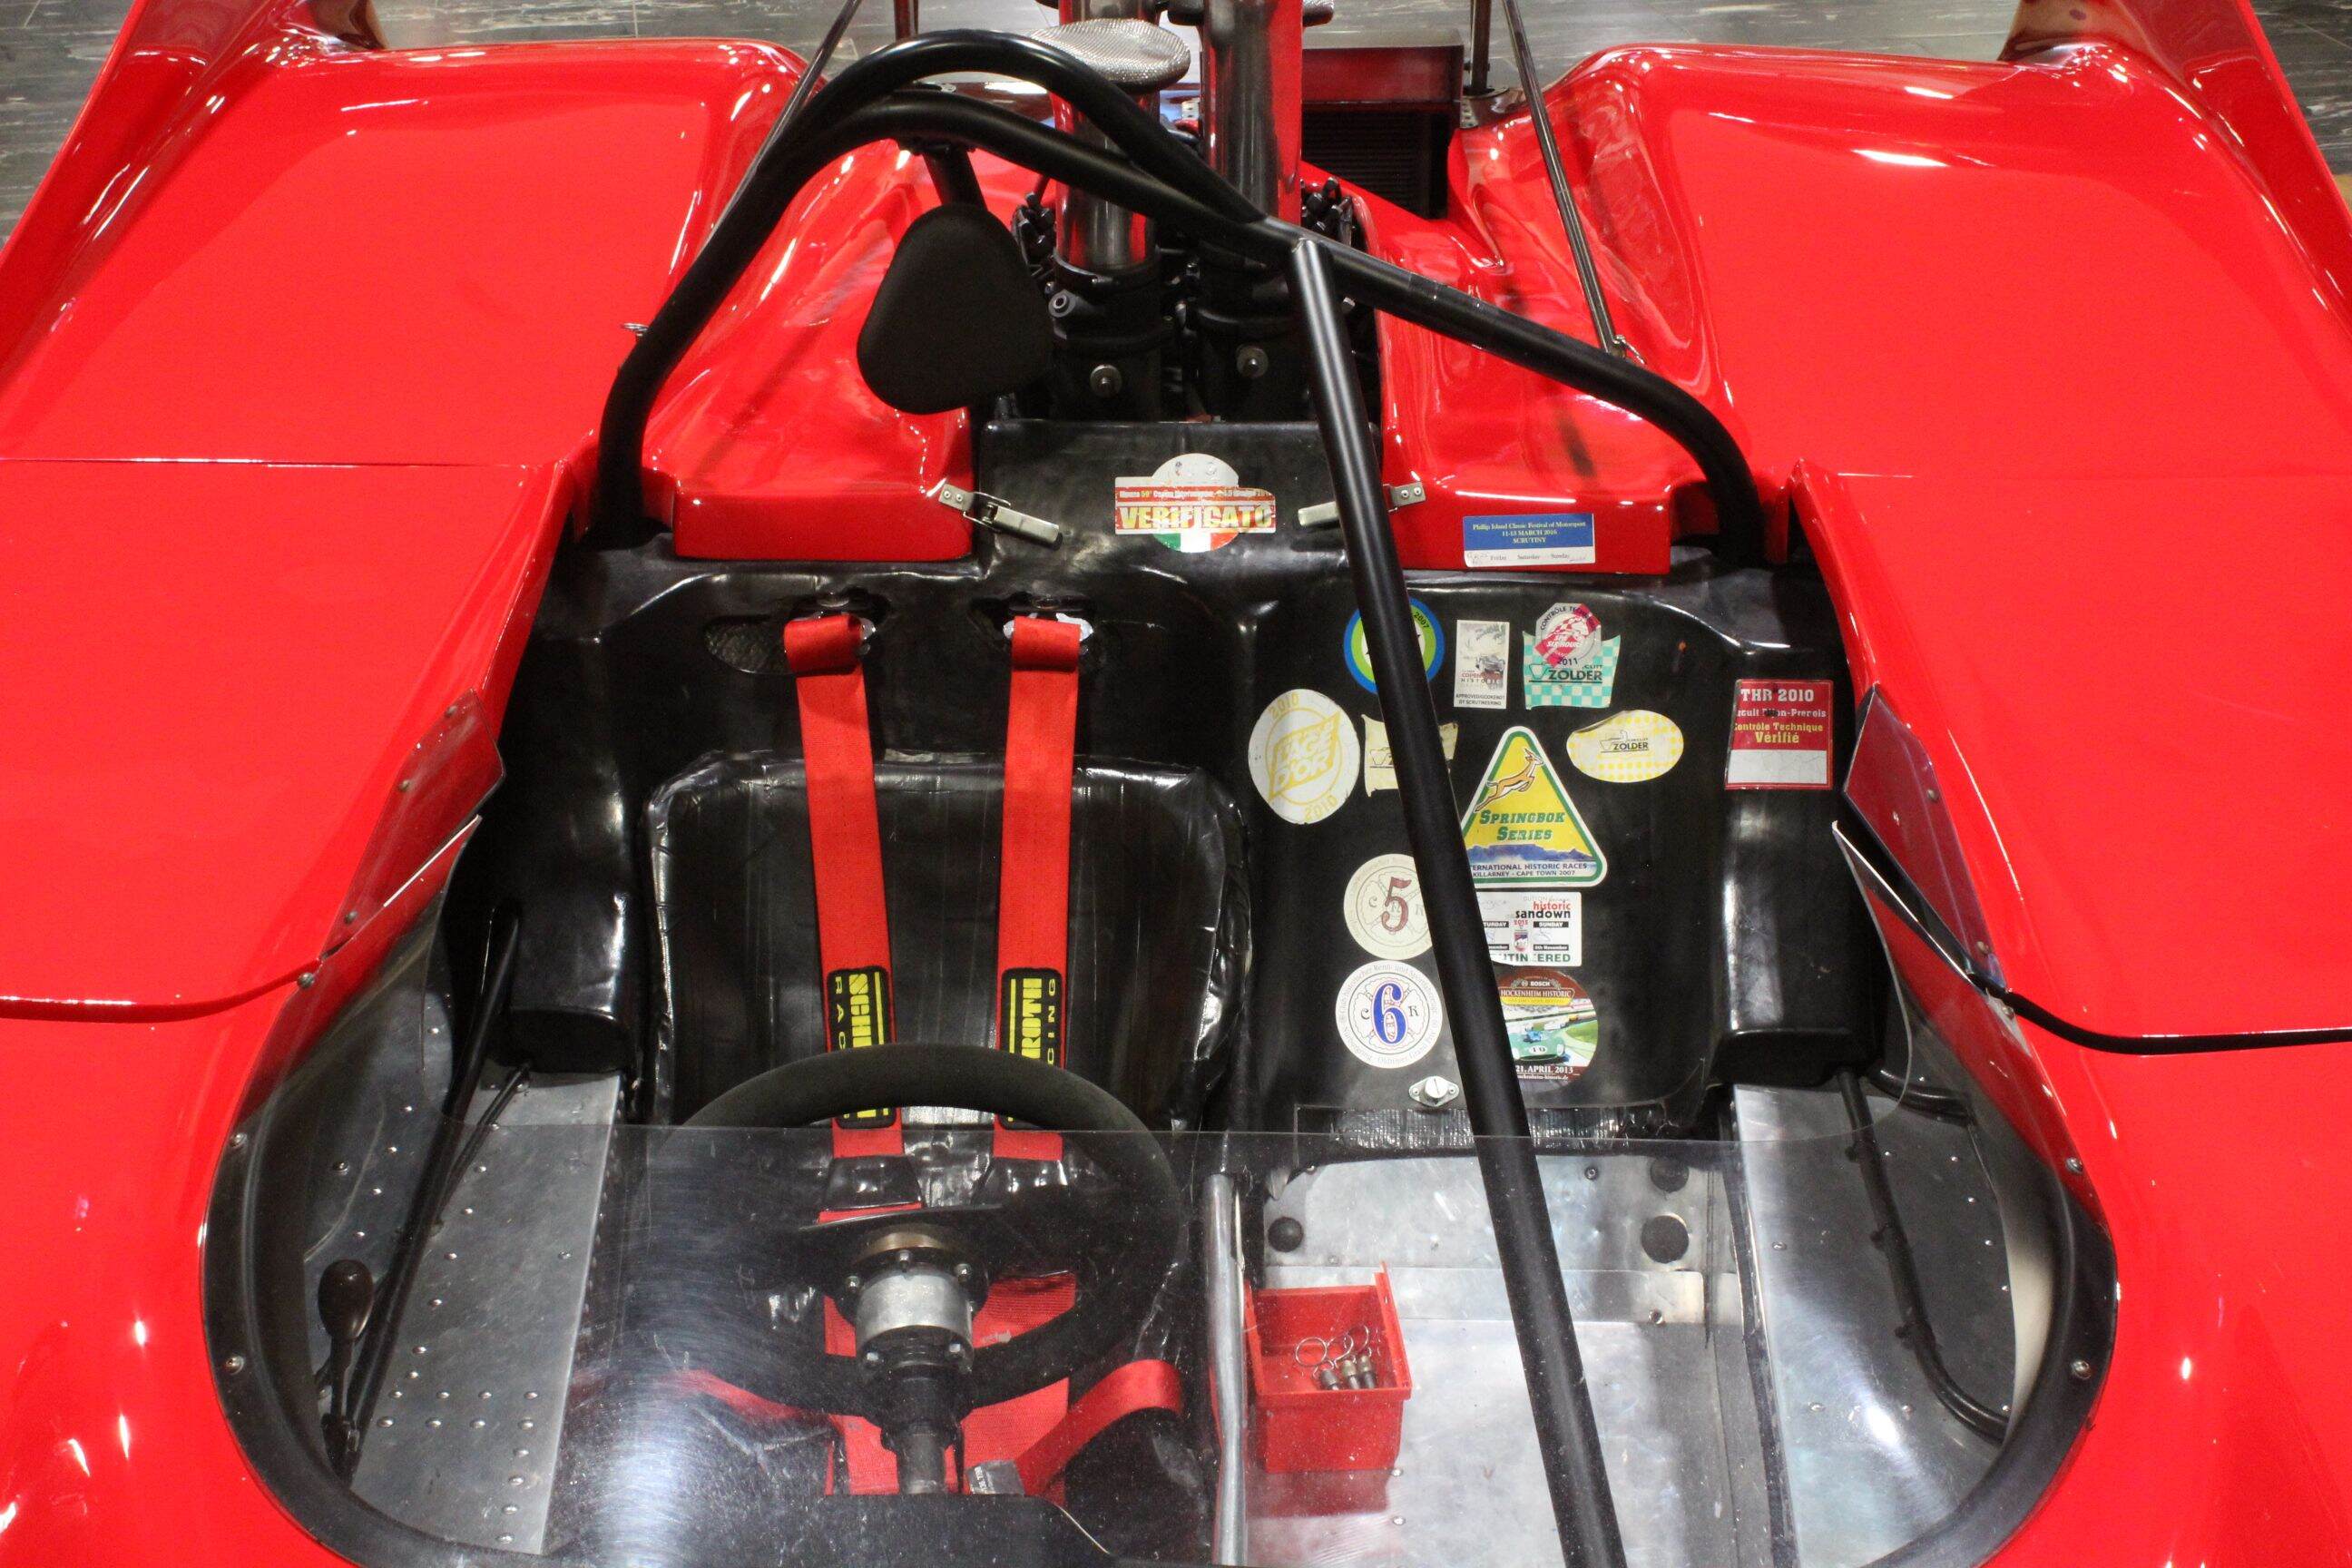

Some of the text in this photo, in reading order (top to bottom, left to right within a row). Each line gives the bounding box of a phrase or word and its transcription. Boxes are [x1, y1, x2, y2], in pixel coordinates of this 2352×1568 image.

[1119, 505, 1271, 528] VERIFICATO
[1414, 612, 1430, 629] 2007
[1557, 657, 1578, 666] 2011
[1548, 670, 1602, 681] ZOLDER
[1740, 688, 1815, 702] THR 2010
[1772, 722, 1824, 732] Technique
[1754, 730, 1800, 744] Vérifié
[1613, 741, 1649, 750] ZOLDER
[1479, 809, 1566, 825] SPRINGBOK
[1496, 826, 1553, 841] SERIES
[1382, 877, 1412, 932] 5
[1534, 901, 1572, 910] historic
[1515, 909, 1571, 919] sandown
[1373, 982, 1407, 1044] 6
[1528, 1064, 1553, 1073] APRIL
[1555, 1065, 1574, 1074] 2013
